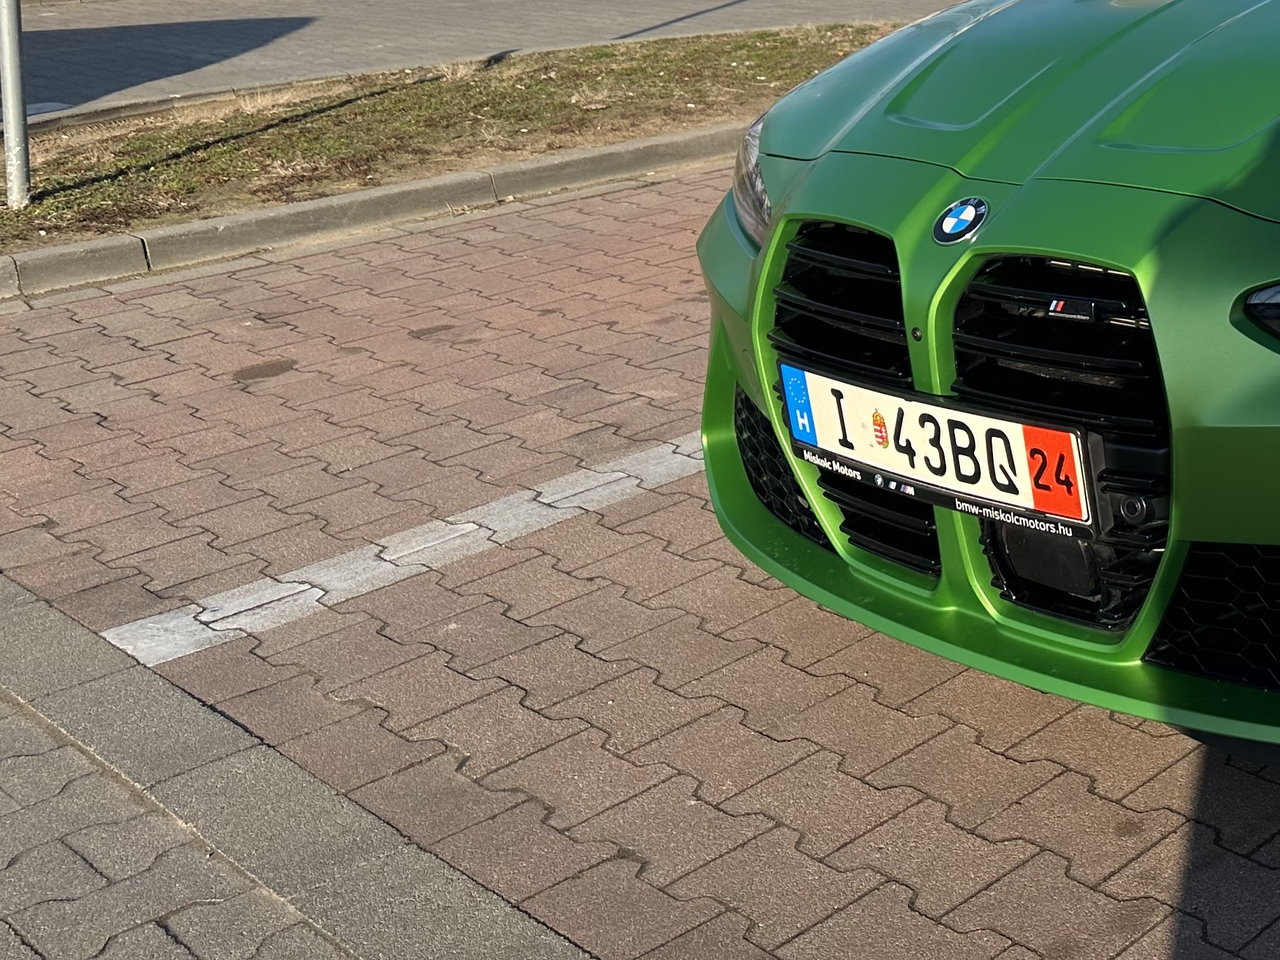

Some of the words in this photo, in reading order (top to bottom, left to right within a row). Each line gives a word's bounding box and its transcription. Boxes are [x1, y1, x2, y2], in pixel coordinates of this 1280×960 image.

[795, 409, 811, 433] H
[803, 449, 833, 471] Miskolc
[832, 460, 862, 481] Motors
[893, 406, 1020, 496] 43BQ
[1029, 447, 1074, 496] 24
[955, 498, 1073, 537] bmw-miskolcmotors.hu
